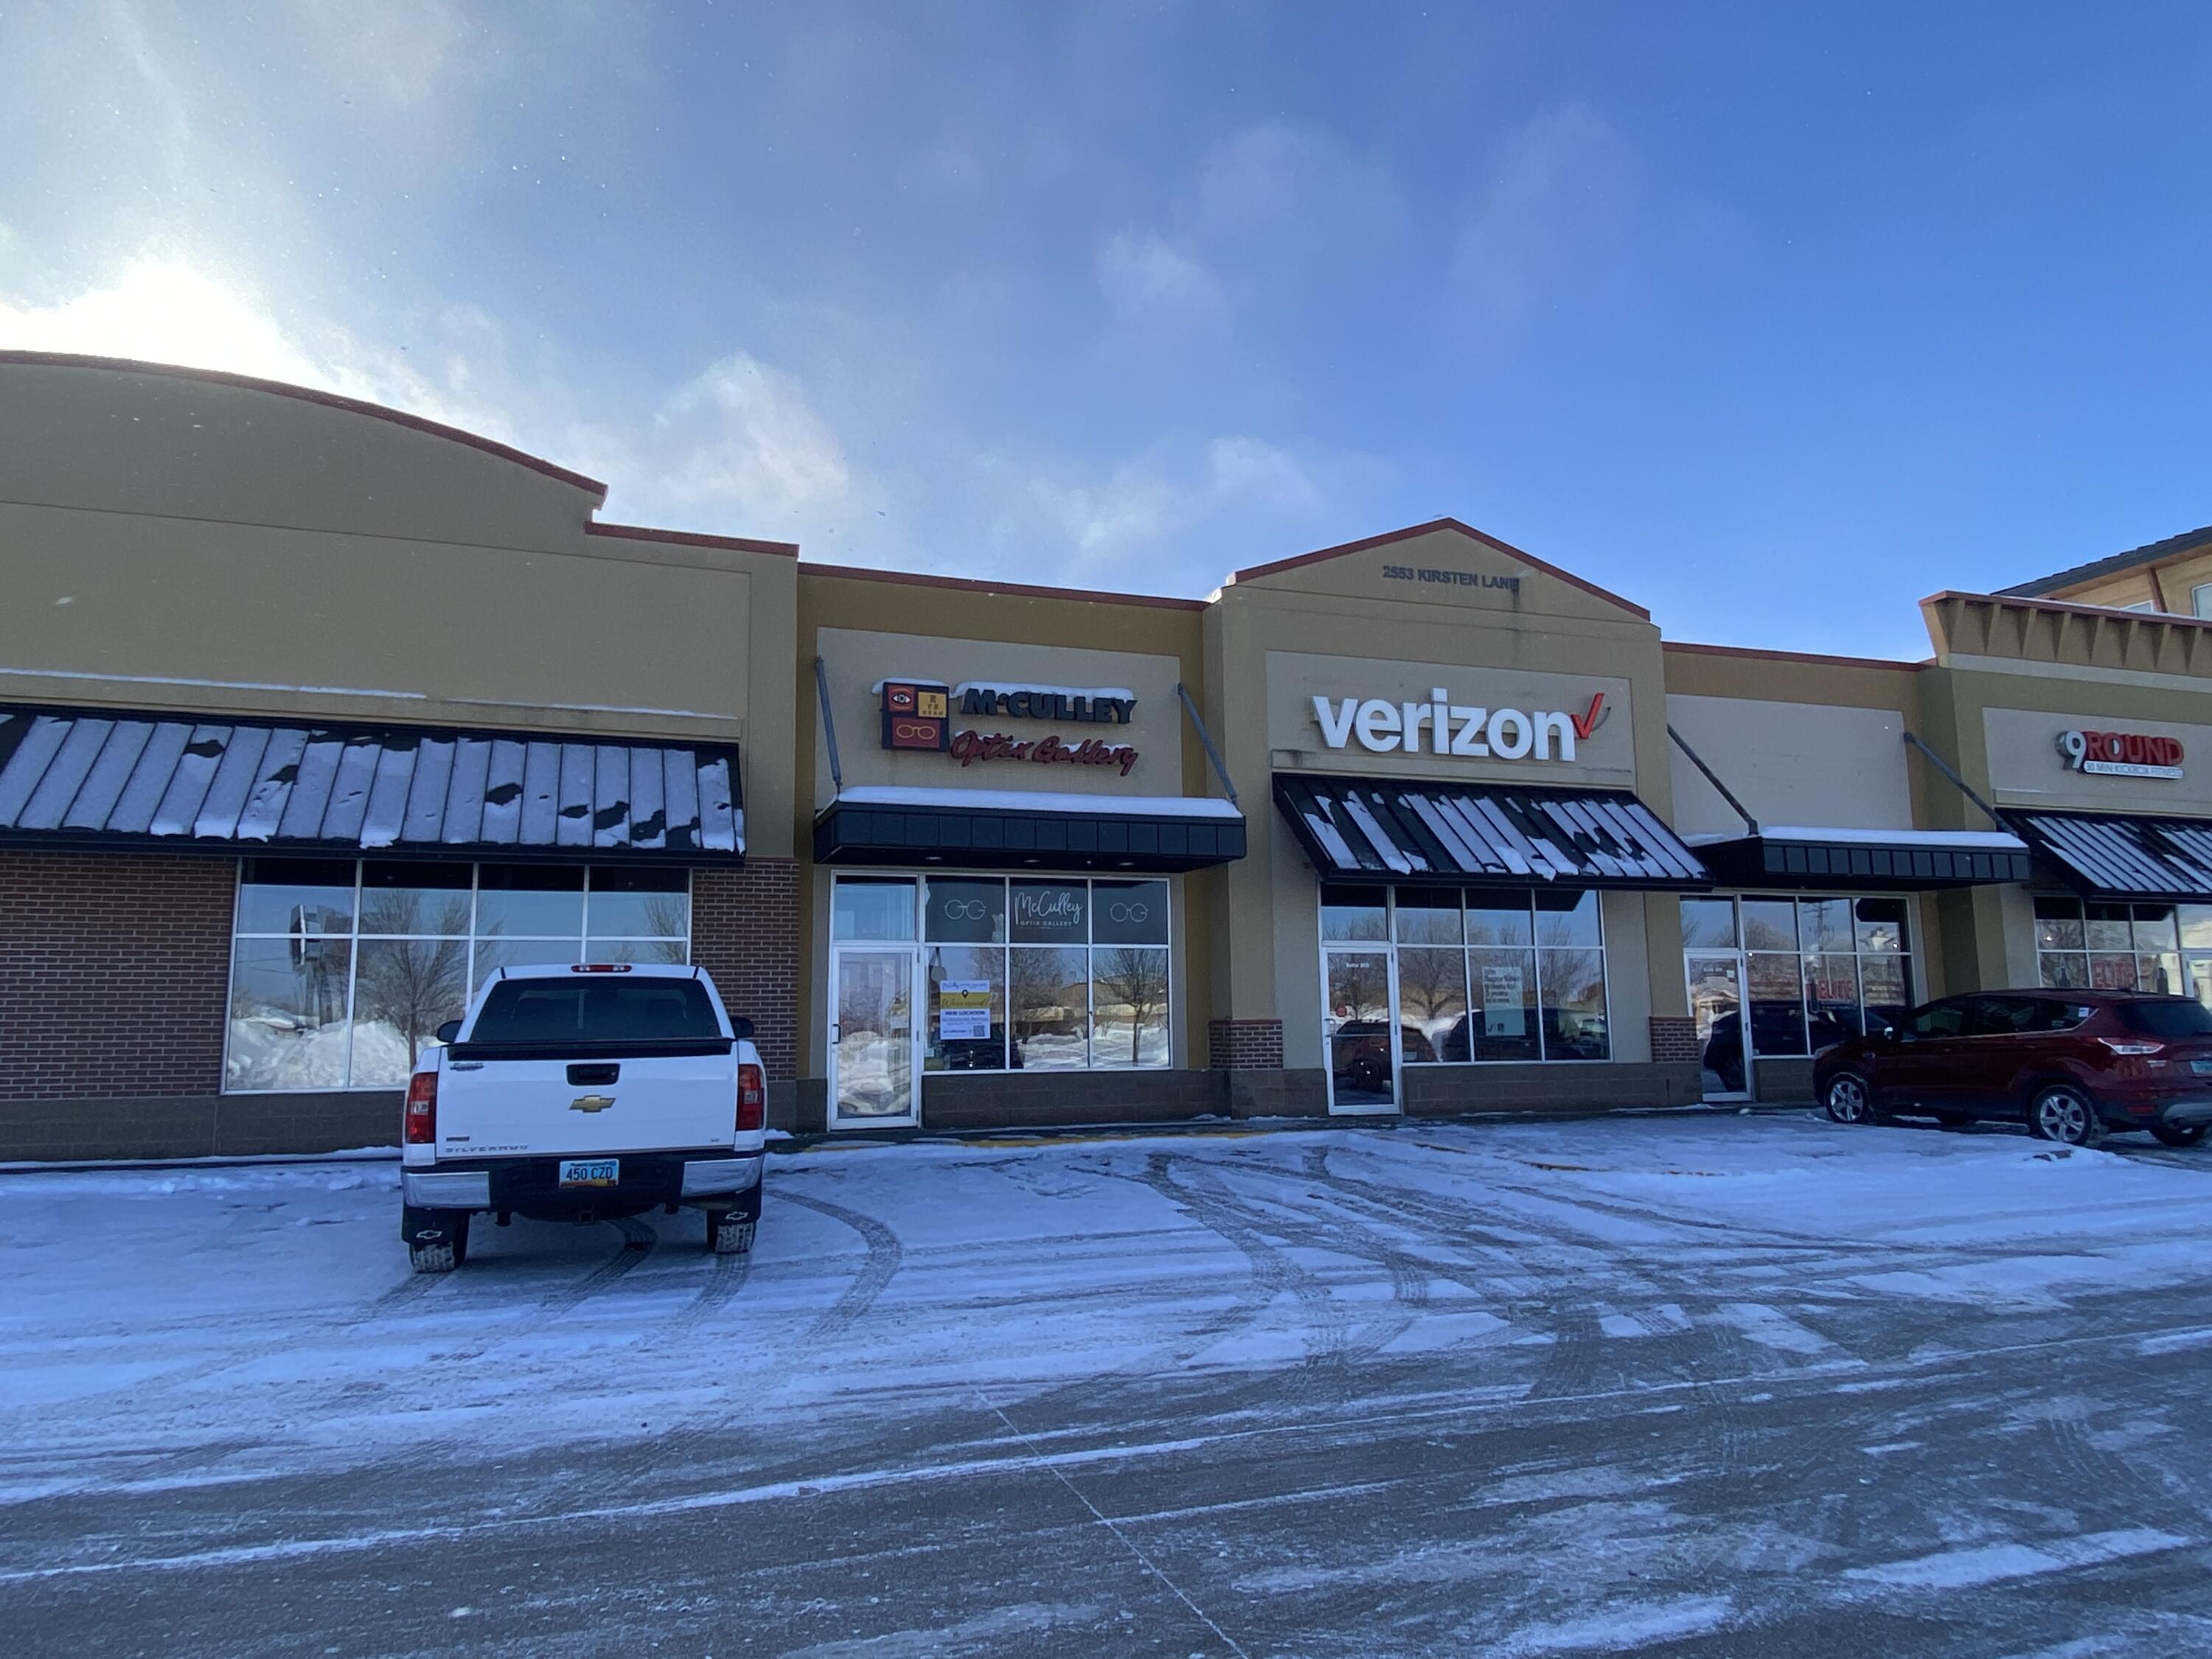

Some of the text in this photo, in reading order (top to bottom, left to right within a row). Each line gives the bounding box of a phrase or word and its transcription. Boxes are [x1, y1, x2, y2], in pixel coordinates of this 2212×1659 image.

[1382, 566, 1520, 590] 2553 KIRSTEN LANE
[1312, 688, 1576, 762] verizon
[446, 1144, 529, 1152] SILVERADO
[566, 1168, 588, 1180] 450
